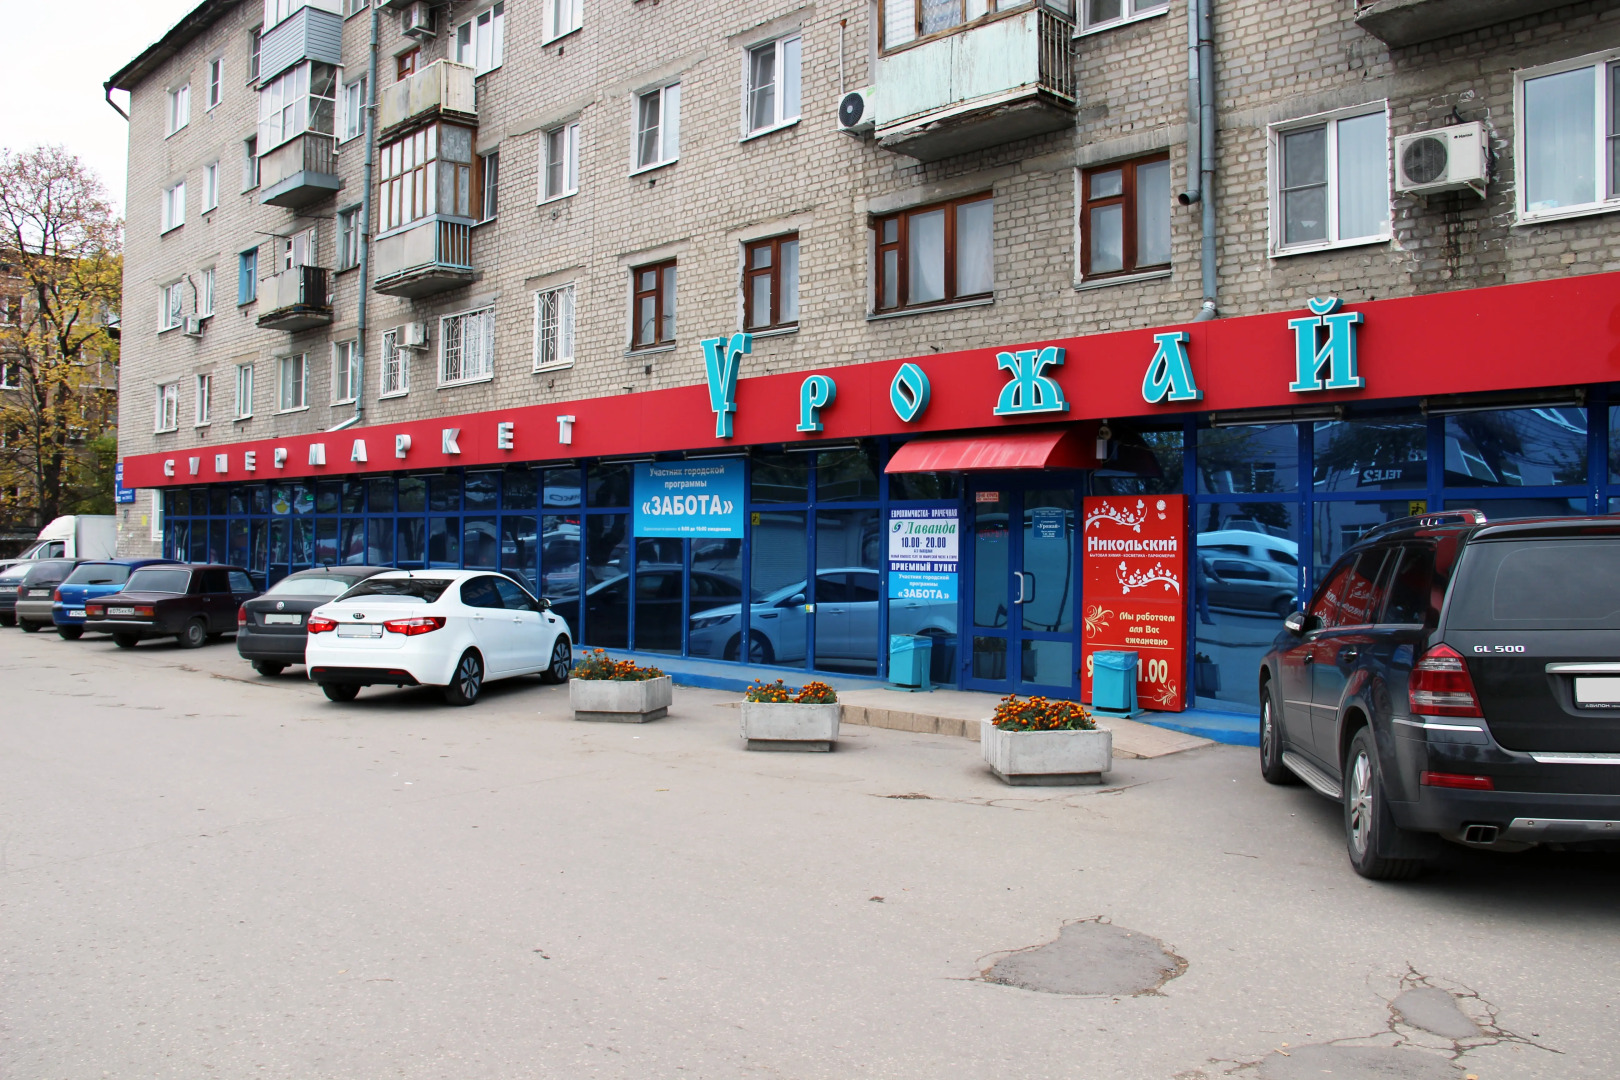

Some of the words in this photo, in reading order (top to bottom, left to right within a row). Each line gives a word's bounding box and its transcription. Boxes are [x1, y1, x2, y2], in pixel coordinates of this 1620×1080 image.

[164, 415, 576, 477] СУПЕРМАРКЕТ
[649, 468, 682, 477] Участник
[684, 465, 724, 477] городской
[664, 480, 707, 490] программы
[642, 495, 733, 515] «ЗАБОТА»
[904, 520, 956, 535] Лаванда
[925, 536, 947, 548] 20.00
[891, 562, 931, 572] ПРИЕМНЫЙ
[933, 563, 957, 572] ПУНКТ
[898, 588, 949, 599] «ЗАБОТА»
[1119, 611, 1134, 621] Мы
[1136, 612, 1176, 622] работаем
[1128, 625, 1143, 633] для
[1145, 625, 1160, 634] Вас
[1125, 637, 1169, 646] ежедневно
[1473, 645, 1491, 653] GL
[1494, 645, 1526, 653] 500
